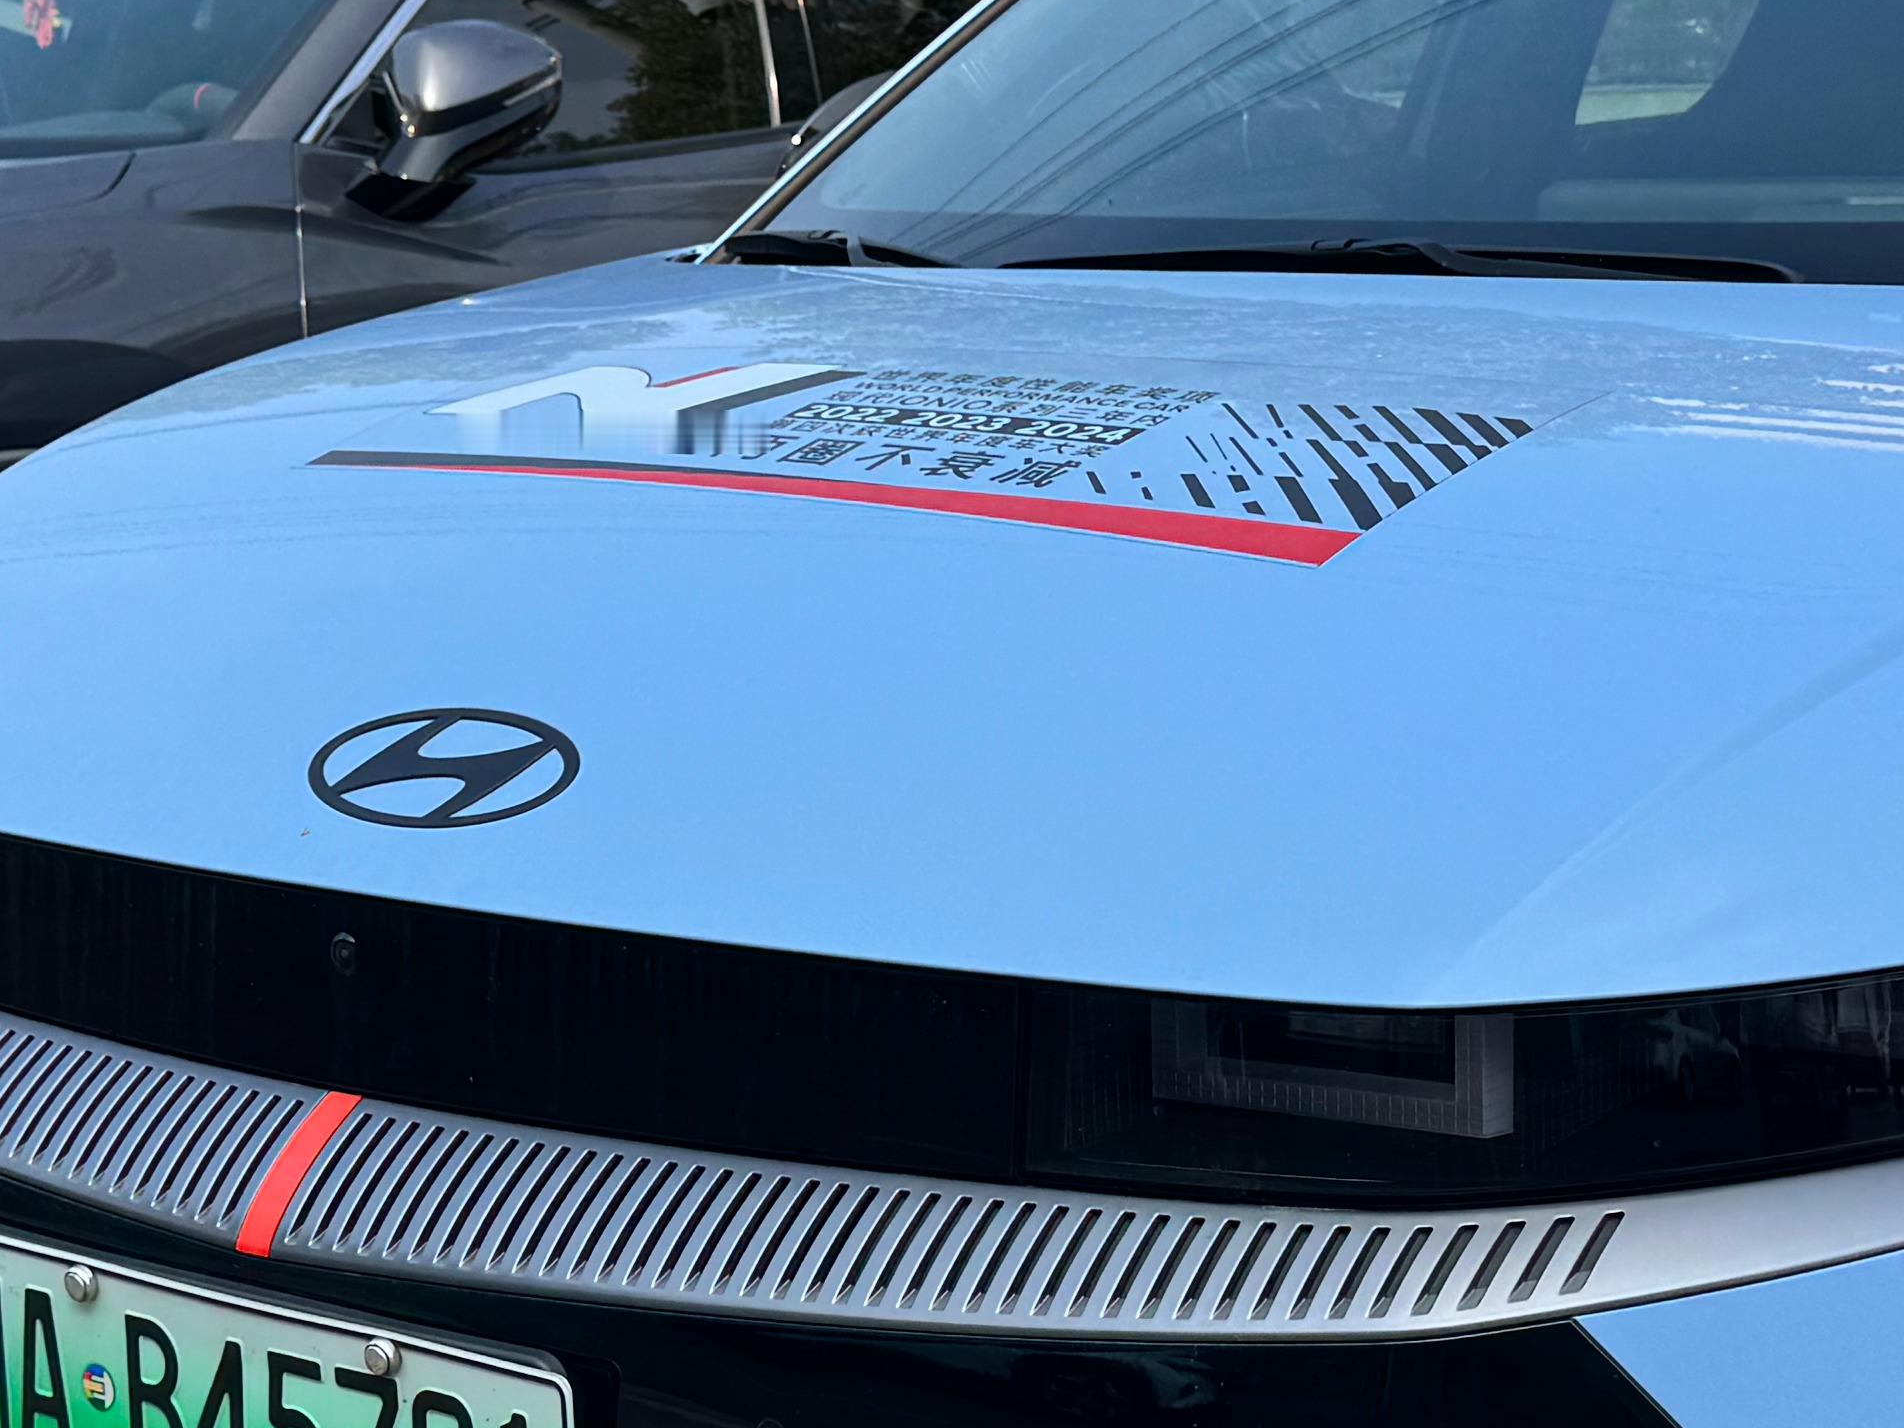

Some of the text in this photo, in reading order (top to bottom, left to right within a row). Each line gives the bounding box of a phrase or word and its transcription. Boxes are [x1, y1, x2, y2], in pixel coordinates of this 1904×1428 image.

[853, 380, 1192, 414] WORLD PERFORMANCE CAR
[793, 403, 1132, 443] 2022 2023 2024
